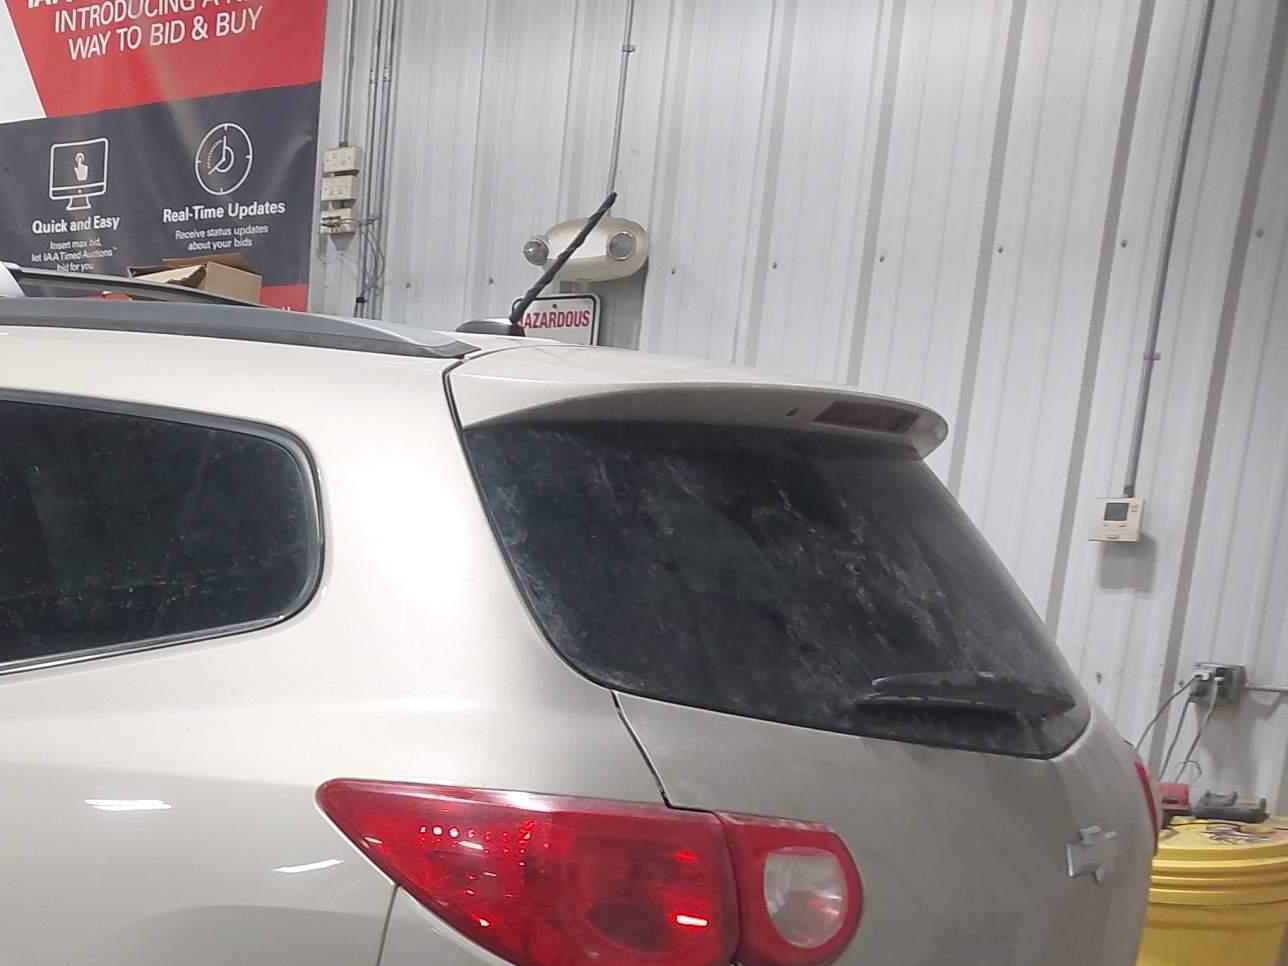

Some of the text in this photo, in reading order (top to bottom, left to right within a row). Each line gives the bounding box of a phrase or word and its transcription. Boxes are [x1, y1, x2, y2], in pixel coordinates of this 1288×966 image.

[55, 0, 195, 33] INTRODUCING
[68, 6, 263, 60] WAY TO BID & BUY
[163, 201, 286, 223] Real-Time Updates
[32, 215, 121, 234] Quick and Easy
[175, 225, 269, 240] Receive status updates
[187, 238, 253, 252] about your bids
